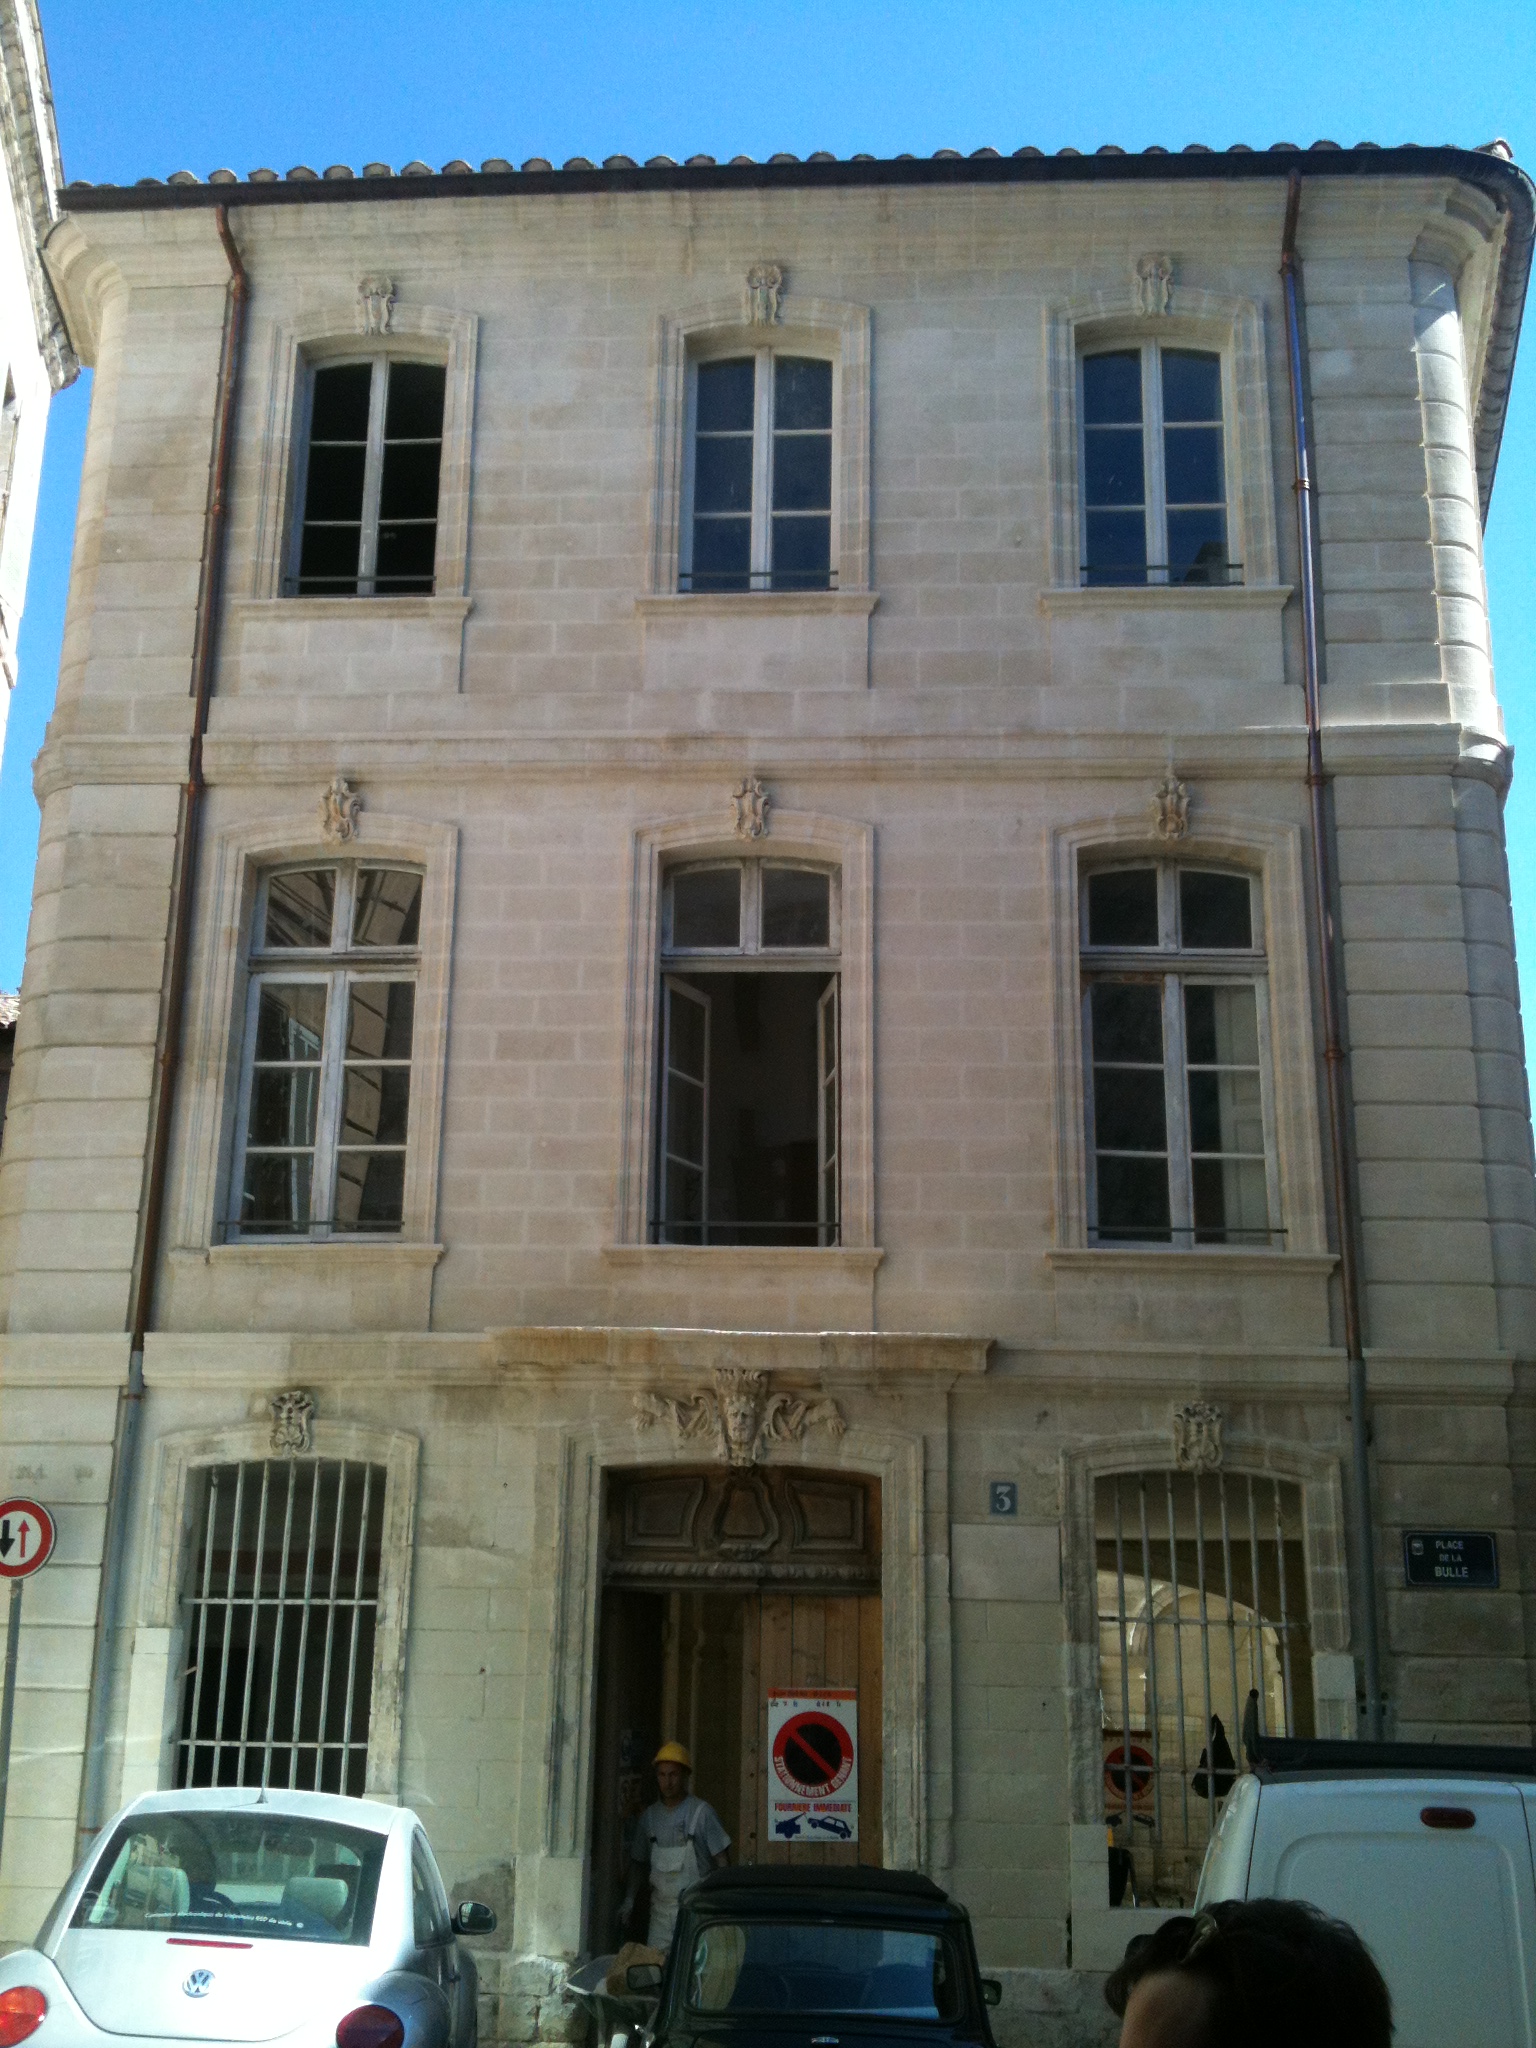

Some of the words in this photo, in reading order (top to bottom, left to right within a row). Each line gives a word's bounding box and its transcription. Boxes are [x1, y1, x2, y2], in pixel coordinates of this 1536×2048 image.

[996, 1485, 1011, 1512] 3
[1435, 1540, 1464, 1550] PLACE
[1439, 1553, 1449, 1562] DE
[1451, 1553, 1462, 1562] LA
[1434, 1566, 1469, 1578] BULLE
[774, 1756, 830, 1796] STATIONNEMENT
